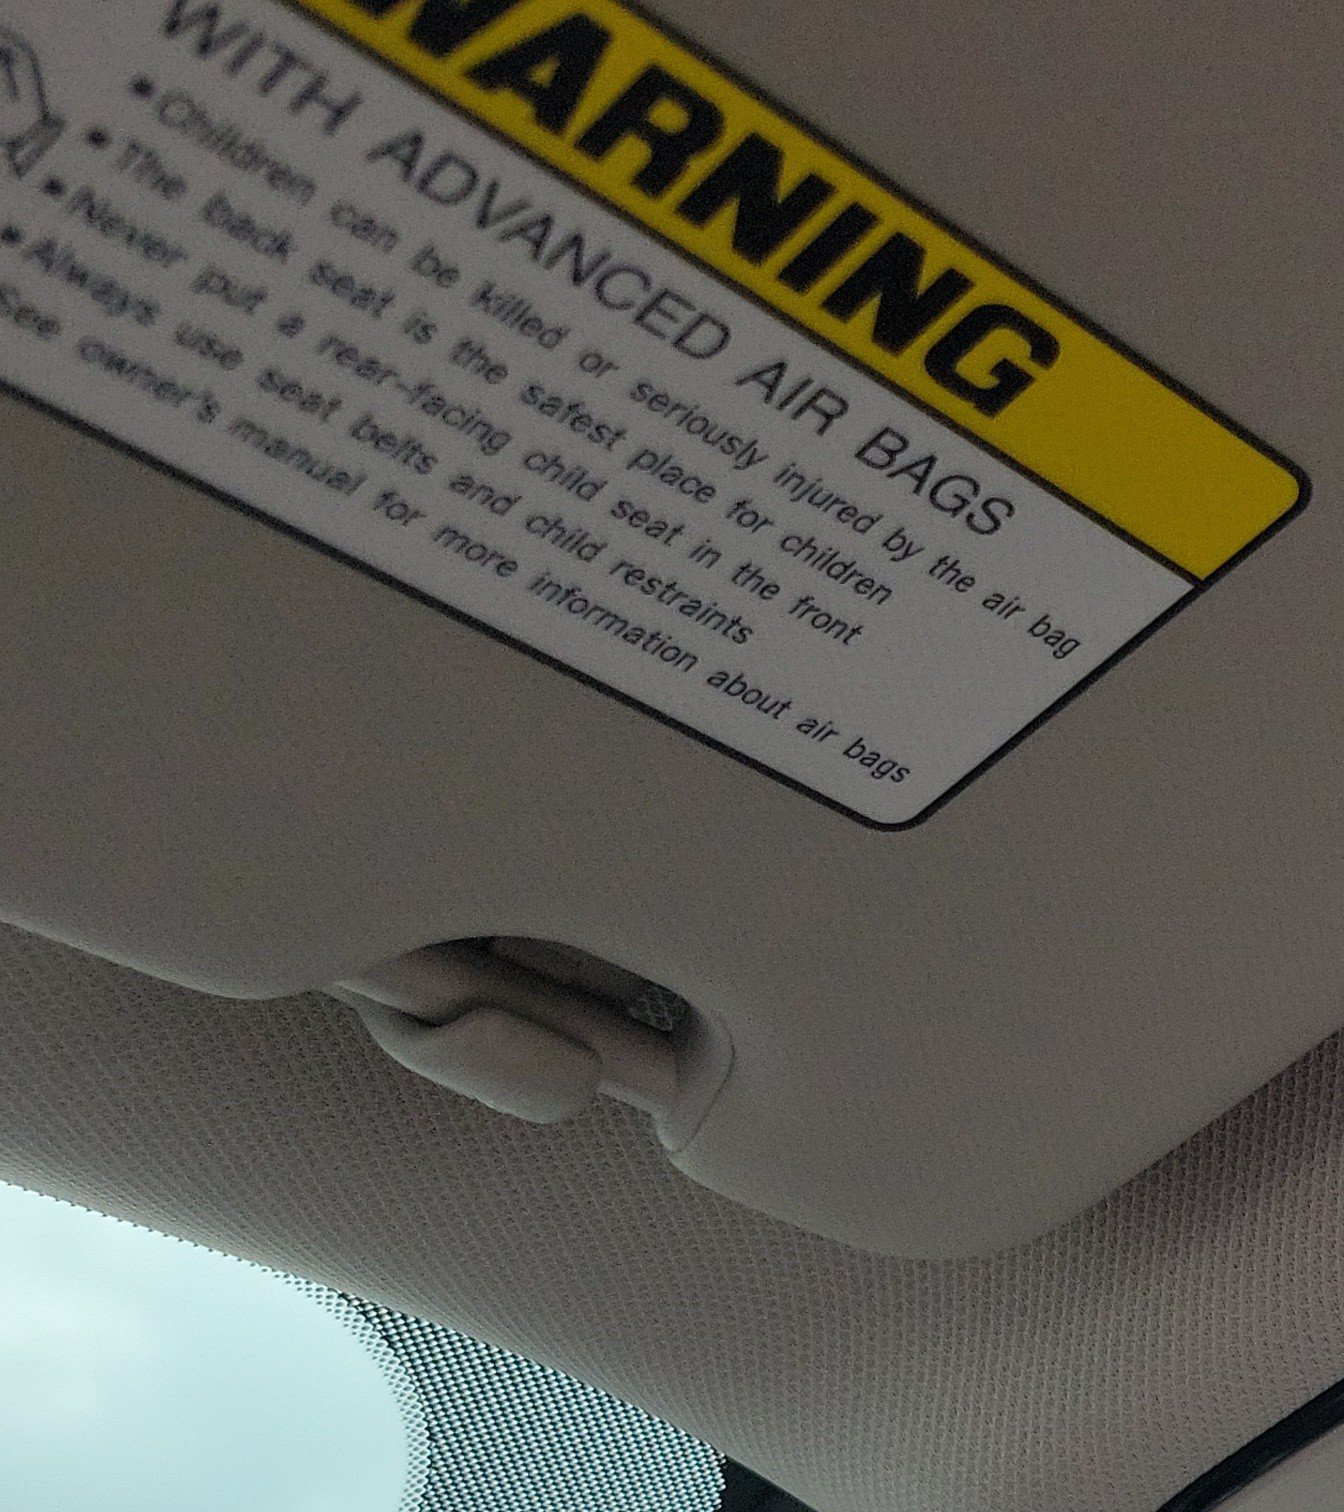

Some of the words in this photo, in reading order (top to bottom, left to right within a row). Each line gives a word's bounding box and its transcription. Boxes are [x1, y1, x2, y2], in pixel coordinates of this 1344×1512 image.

[23, 236, 160, 326] Always
[174, 321, 245, 371] use
[255, 366, 343, 423] seat
[350, 413, 439, 476] belts
[448, 472, 523, 517] and
[524, 513, 609, 563] child
[608, 559, 755, 645] restraints
[67, 186, 188, 267] Never
[191, 263, 267, 314] put
[277, 311, 305, 338] a
[317, 334, 512, 457] rear-facing
[523, 451, 609, 502] child
[610, 499, 685, 548] seat
[688, 538, 723, 570] in
[731, 563, 781, 601] the
[788, 594, 863, 647] front
[117, 139, 188, 201] The
[203, 190, 293, 264] back
[308, 258, 395, 319] seat
[403, 307, 438, 346] is
[451, 338, 509, 385] the
[520, 380, 627, 452] safest
[626, 447, 717, 504] place
[725, 498, 775, 534] for
[780, 534, 893, 606] children
[158, 88, 318, 206] Children
[330, 199, 399, 252] can
[410, 246, 462, 289] be
[470, 281, 571, 350] killed
[578, 350, 620, 379] or
[628, 380, 769, 471] seriously
[772, 461, 884, 535] injured
[881, 527, 926, 563] by
[928, 555, 976, 594] the
[982, 589, 1027, 621] air
[1028, 613, 1082, 660] bag
[163, 0, 364, 136] WITH
[365, 127, 731, 359] ADVANCED
[734, 361, 849, 436] AIR
[854, 426, 1015, 536] BAGS
[77, 336, 222, 424] owner's
[228, 413, 368, 495] manual
[373, 488, 427, 527] for
[431, 523, 519, 578] more
[526, 570, 699, 673] information
[705, 669, 793, 721] about
[796, 715, 840, 744] air
[842, 736, 912, 785] bags
